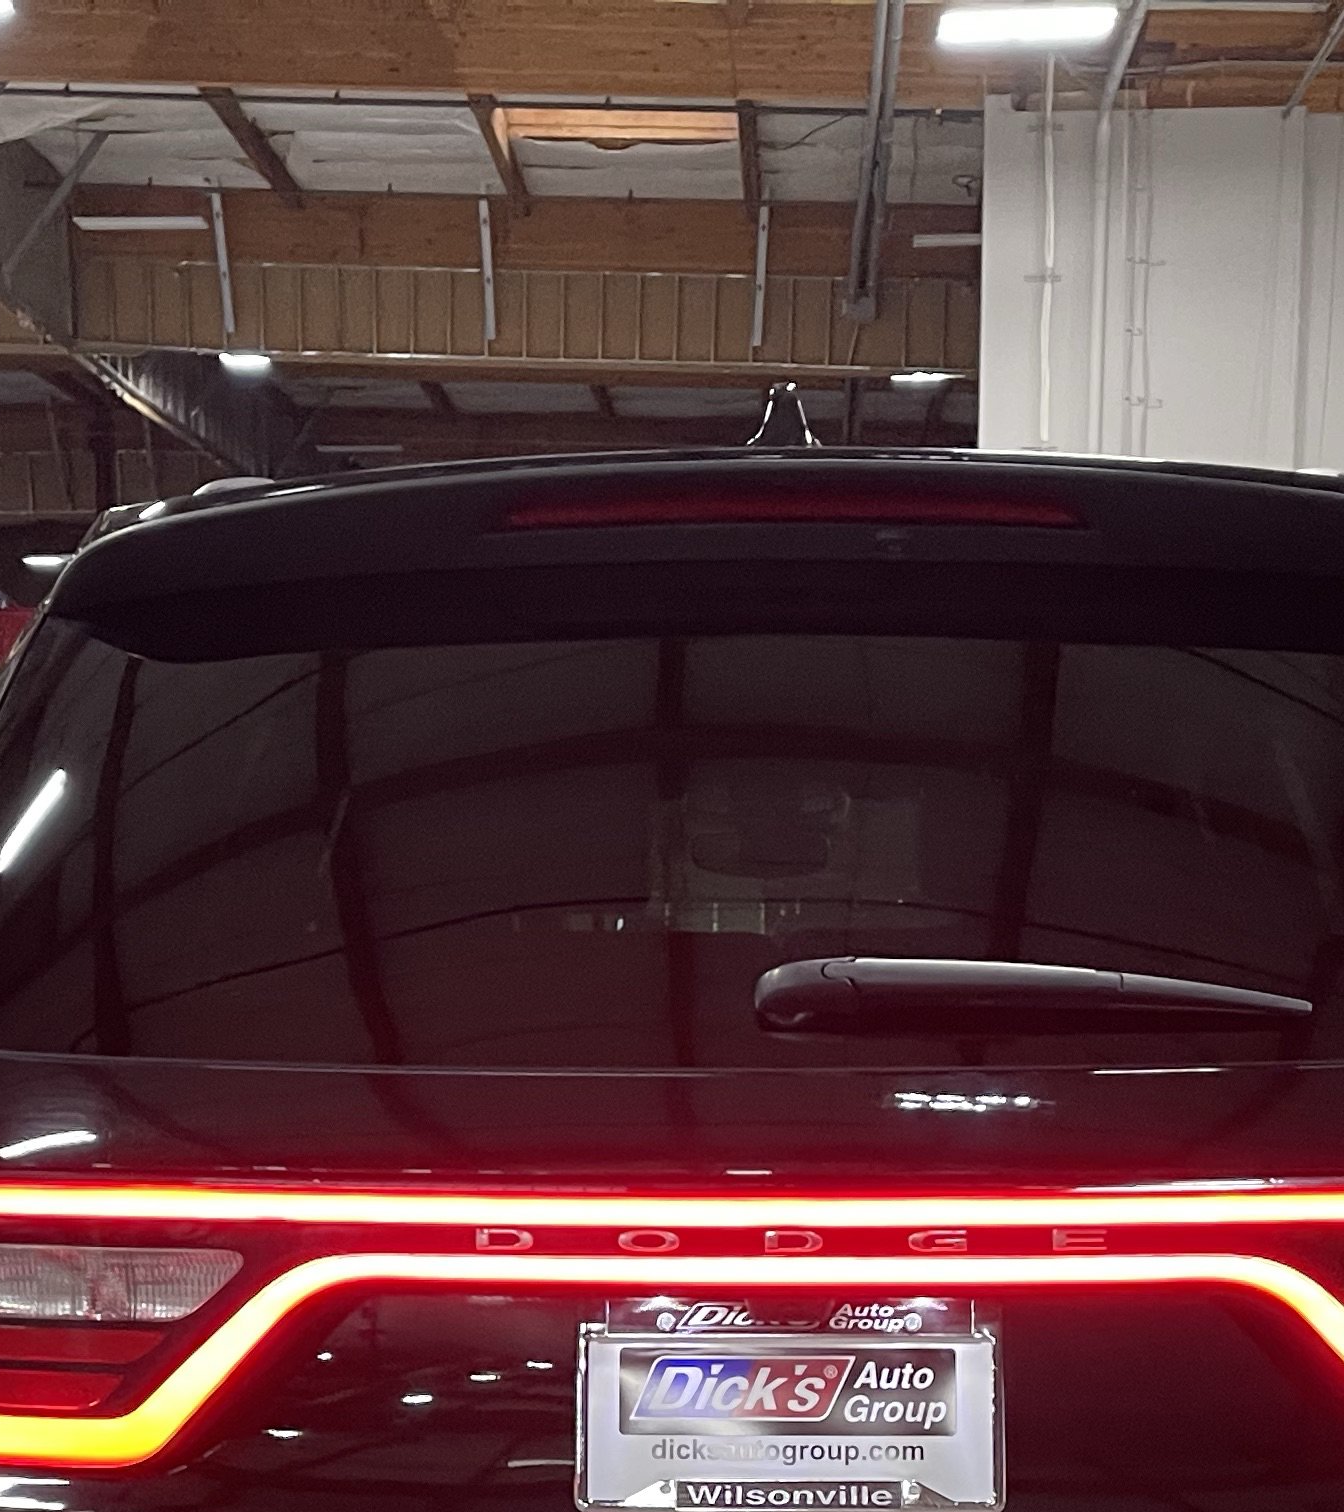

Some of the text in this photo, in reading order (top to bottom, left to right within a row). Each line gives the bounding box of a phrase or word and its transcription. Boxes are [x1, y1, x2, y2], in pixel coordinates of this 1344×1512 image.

[475, 1228, 1108, 1252] DODGE
[835, 1303, 895, 1318] Auto
[829, 1316, 906, 1333] Group
[648, 1363, 825, 1413] Dick's
[854, 1361, 935, 1390] Auto
[843, 1395, 947, 1429] Group
[651, 1438, 925, 1465] dicksautogroup.com
[686, 1484, 893, 1506] Wilsonville
